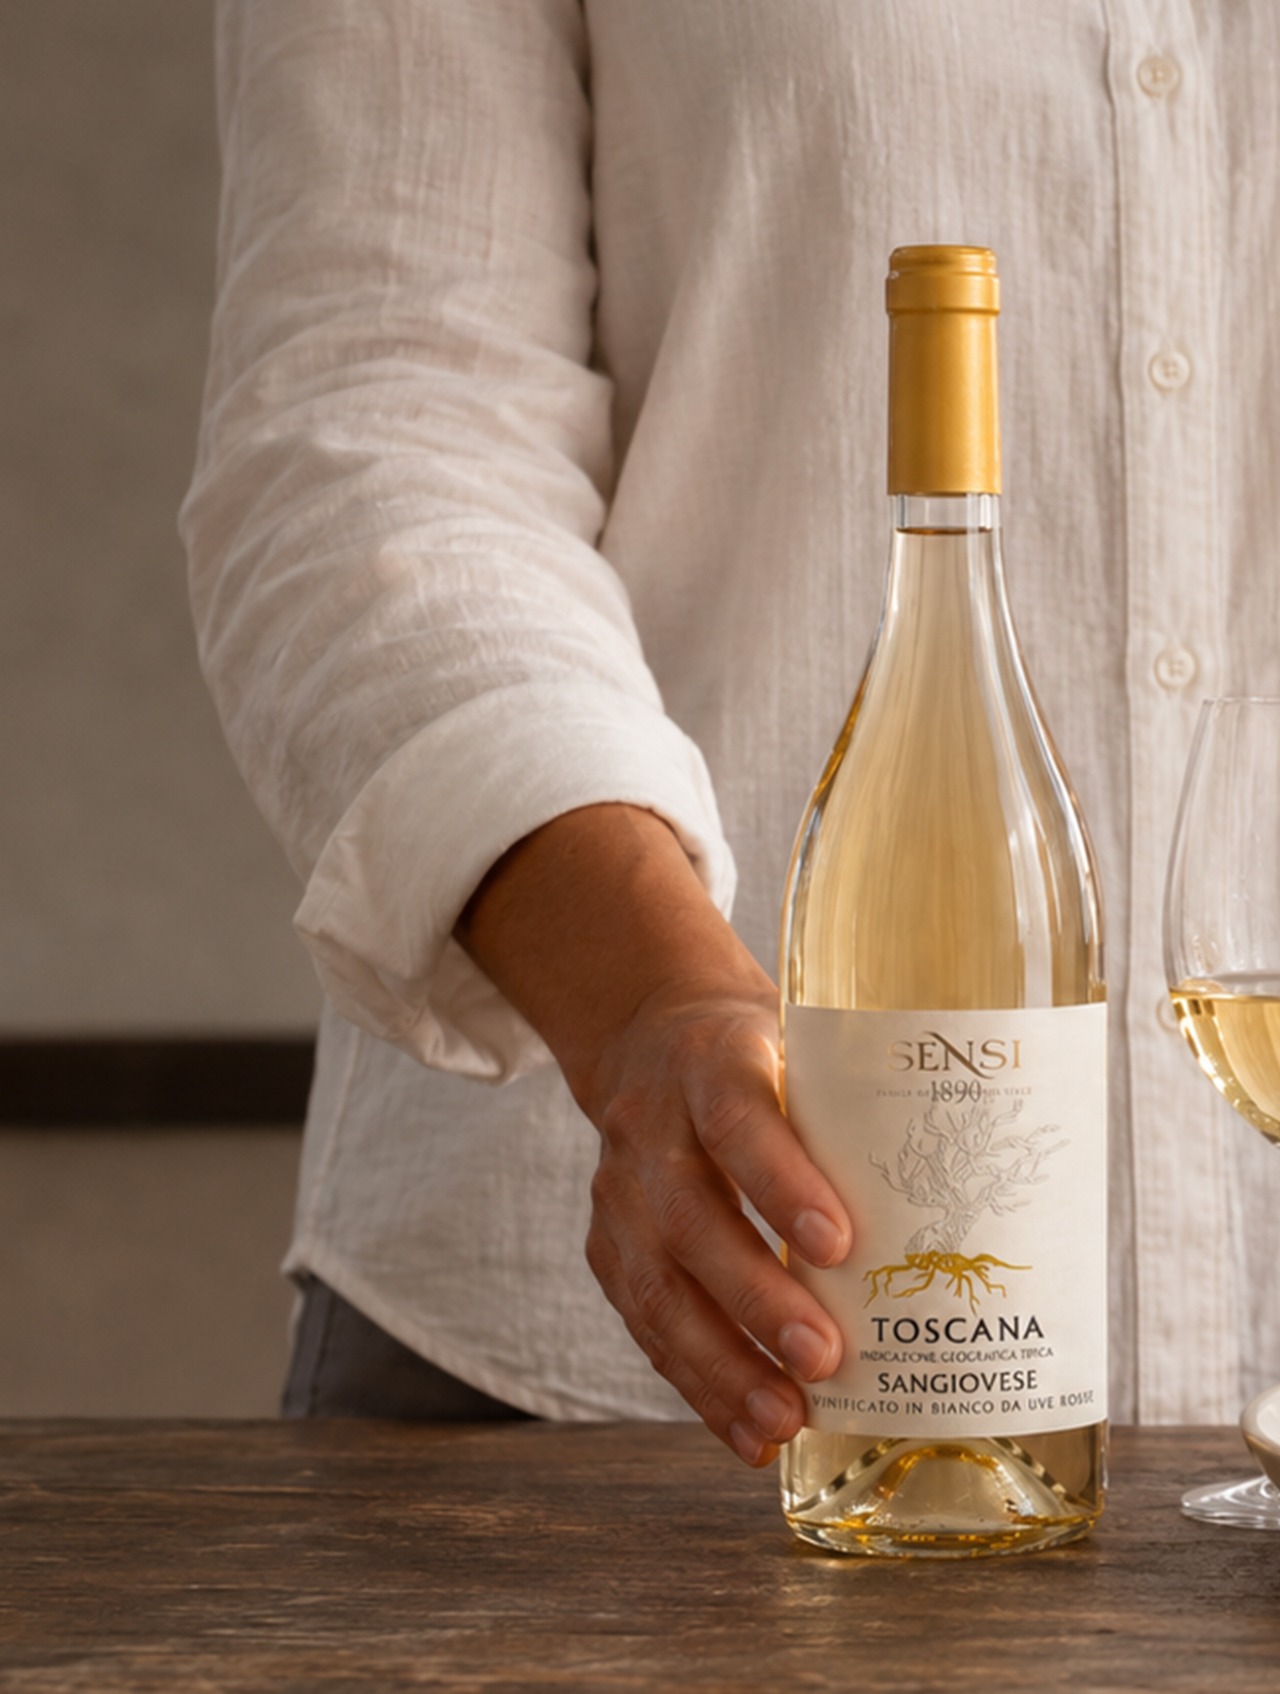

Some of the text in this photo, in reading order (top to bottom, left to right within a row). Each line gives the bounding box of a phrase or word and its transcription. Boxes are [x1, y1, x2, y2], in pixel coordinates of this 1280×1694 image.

[887, 1031, 1021, 1079] SENSI
[930, 1079, 981, 1105] 1890
[871, 1316, 1044, 1344] TOSCANA
[878, 1369, 1038, 1394] SANGIOVESE
[812, 1394, 899, 1415] VINIFICATO
[905, 1402, 923, 1414] IN
[931, 1400, 994, 1415] BIANCO
[1001, 1399, 1021, 1413] DA
[1028, 1396, 1054, 1411] UVE
